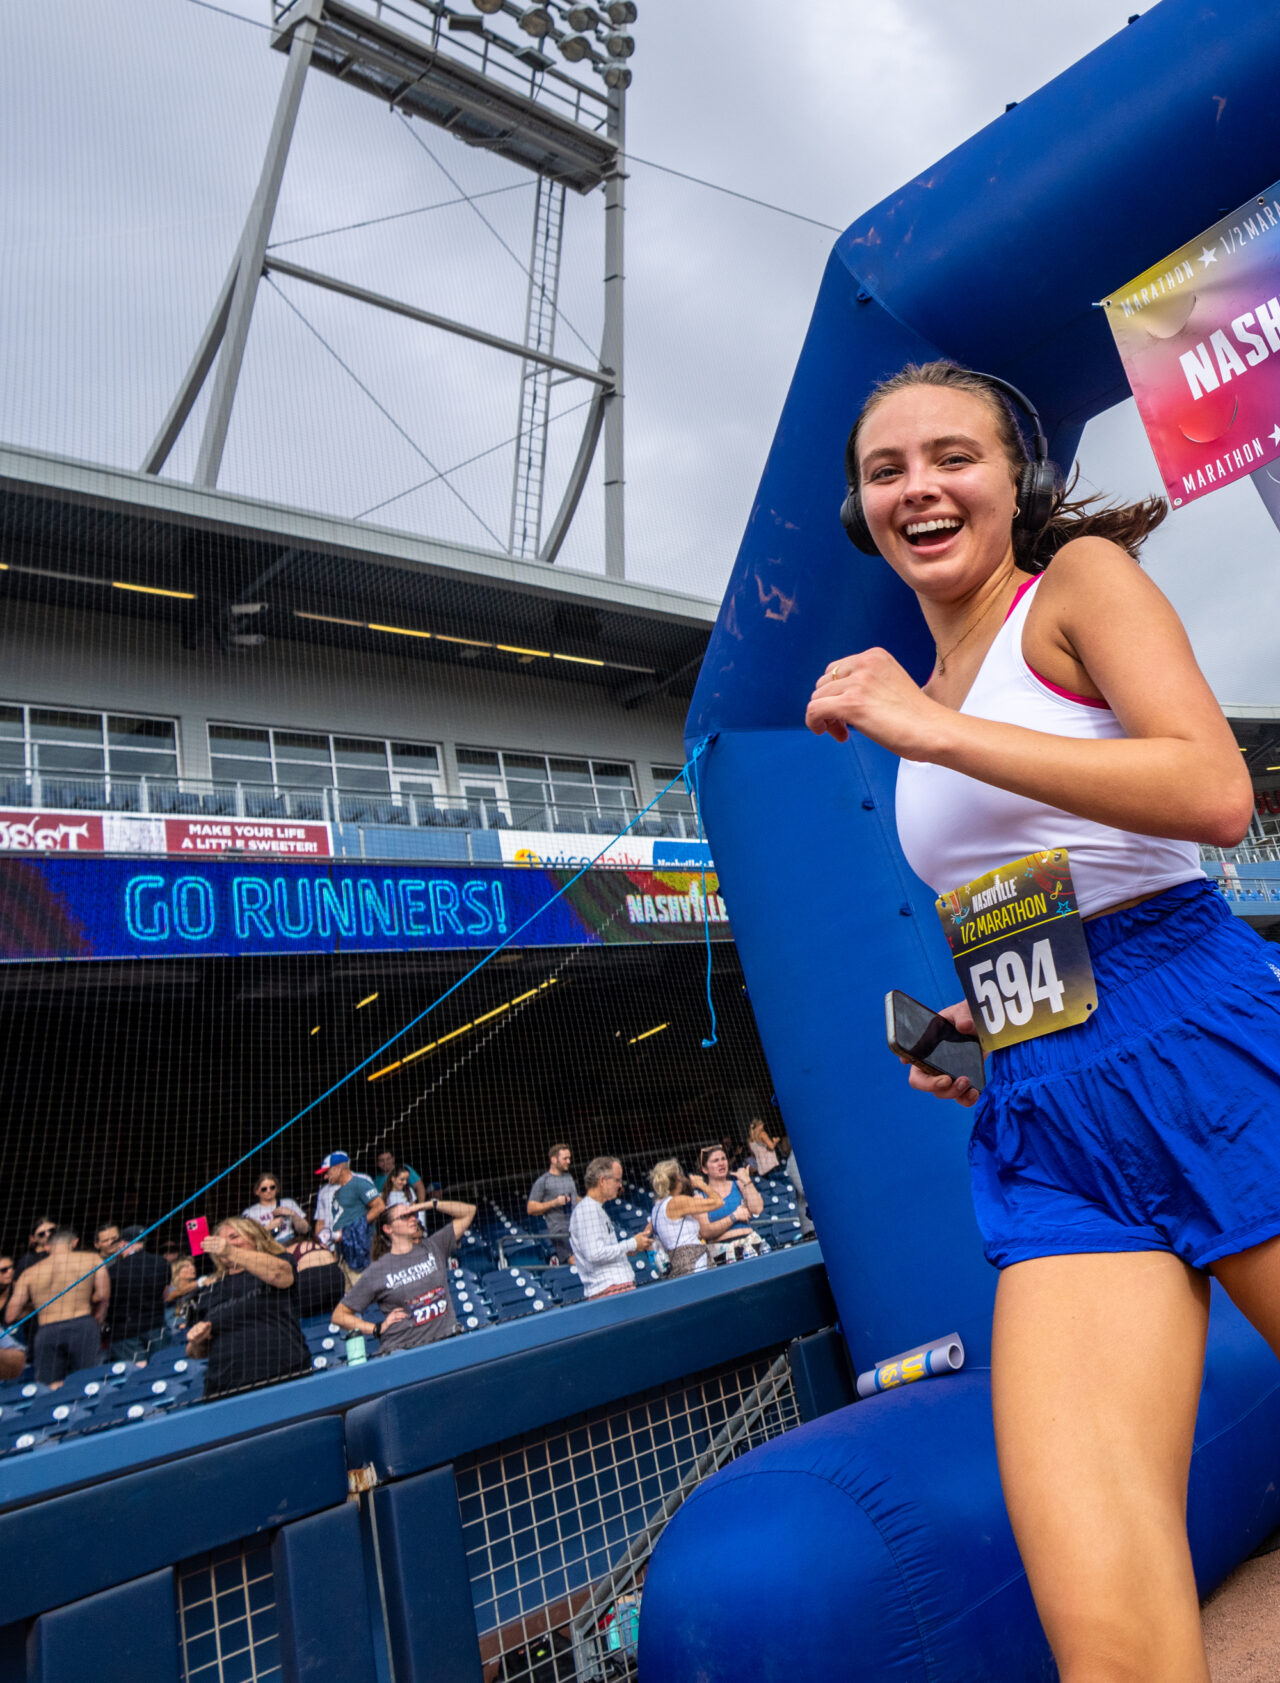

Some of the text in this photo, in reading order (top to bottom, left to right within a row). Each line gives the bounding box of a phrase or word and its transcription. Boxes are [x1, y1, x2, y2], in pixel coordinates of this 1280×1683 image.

[1120, 260, 1195, 318] MARATHON
[1182, 438, 1265, 494] MARATHON
[181, 837, 318, 853] A LITTLE SWEETER!
[188, 823, 306, 839] MAKE YOUR LIFE
[124, 875, 508, 941] GO RUNNERS!
[960, 893, 1048, 945] 1/2 MARATHON
[969, 938, 1065, 1035] 594
